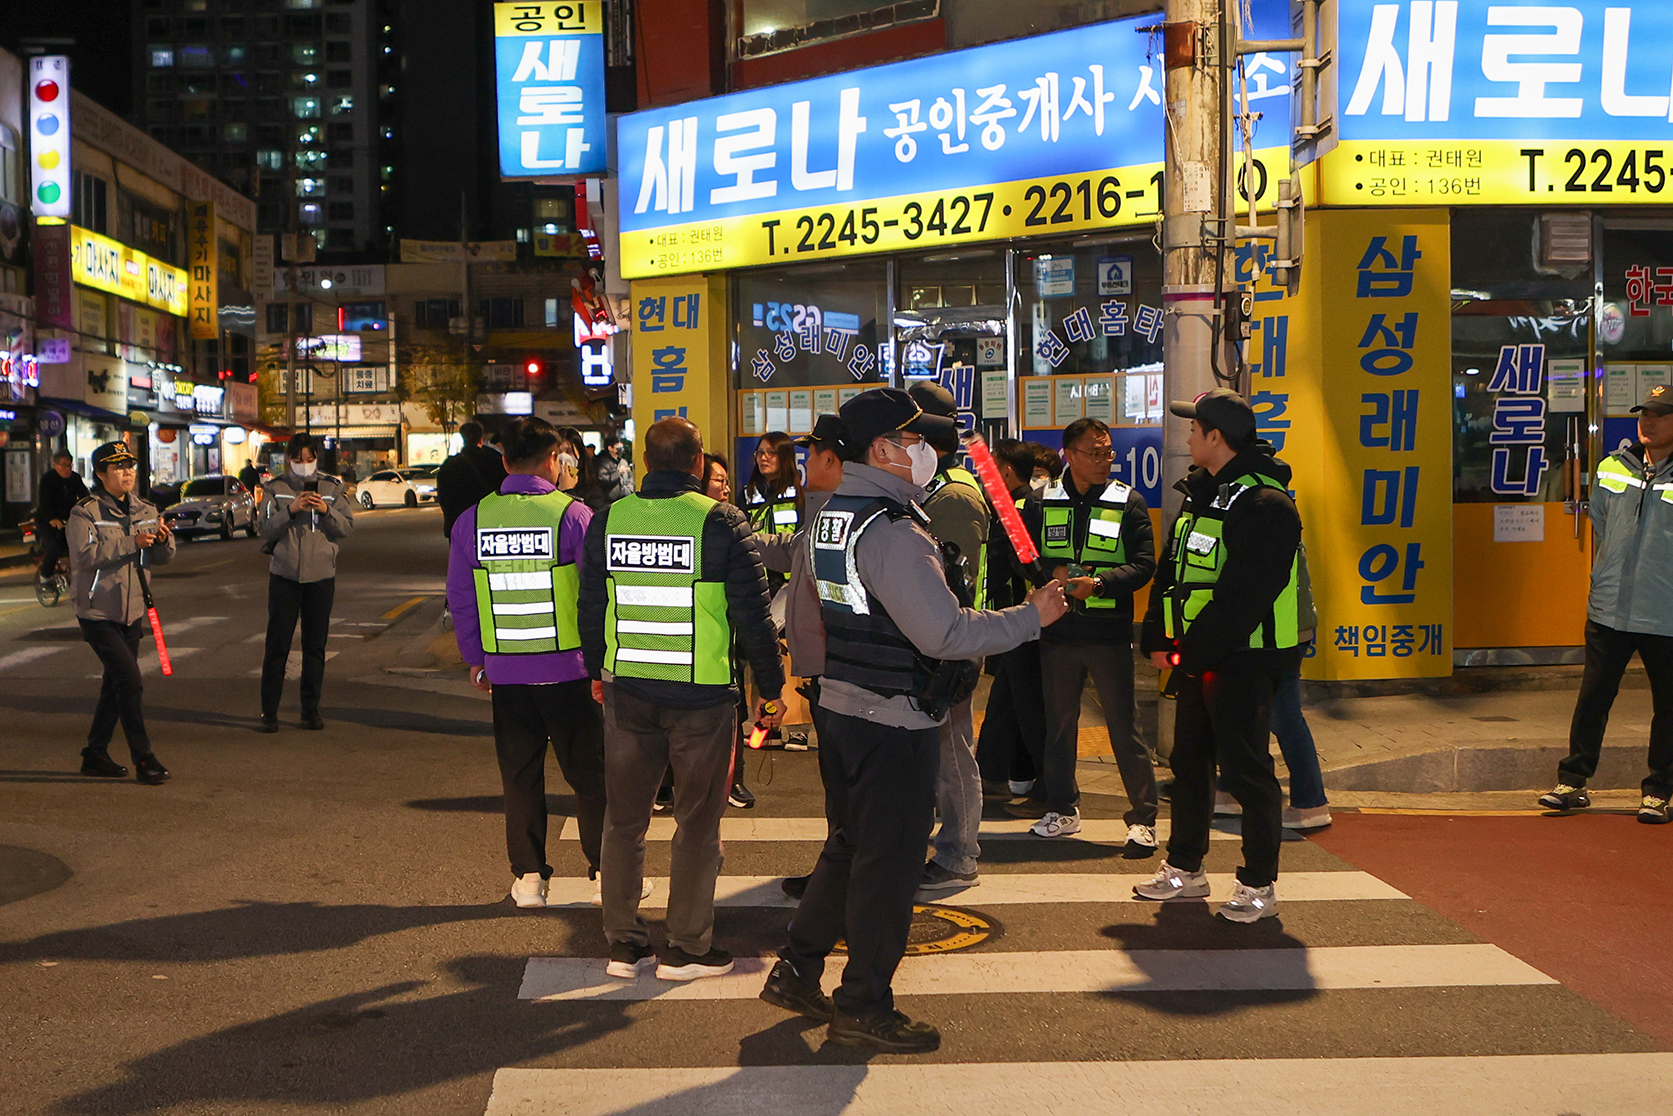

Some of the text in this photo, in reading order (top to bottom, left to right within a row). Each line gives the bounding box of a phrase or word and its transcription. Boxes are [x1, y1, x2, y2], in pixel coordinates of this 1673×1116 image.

[510, 4, 586, 33] 공인
[511, 39, 591, 170] 새로나
[633, 87, 867, 215] 새로나
[883, 63, 1115, 164] 공인중개사
[1368, 149, 1484, 168] 대표 권태원
[1368, 177, 1482, 197] 공인 136번
[656, 226, 724, 248] 대표 권태원
[86, 241, 120, 285] 마사지
[656, 247, 724, 269] 공인 136번
[148, 265, 176, 304] 마사지
[193, 265, 211, 324] 마사지
[1625, 264, 1673, 317] 한국
[637, 292, 700, 333] 현대
[649, 345, 689, 393] 홈
[750, 322, 876, 382] 삼성래미안
[1355, 234, 1425, 606] 삼성래미안
[1486, 343, 1550, 497] 새로나
[481, 532, 549, 555] 자율방범대
[611, 541, 690, 568] 자율방범대
[1334, 624, 1443, 658] 책임중개
